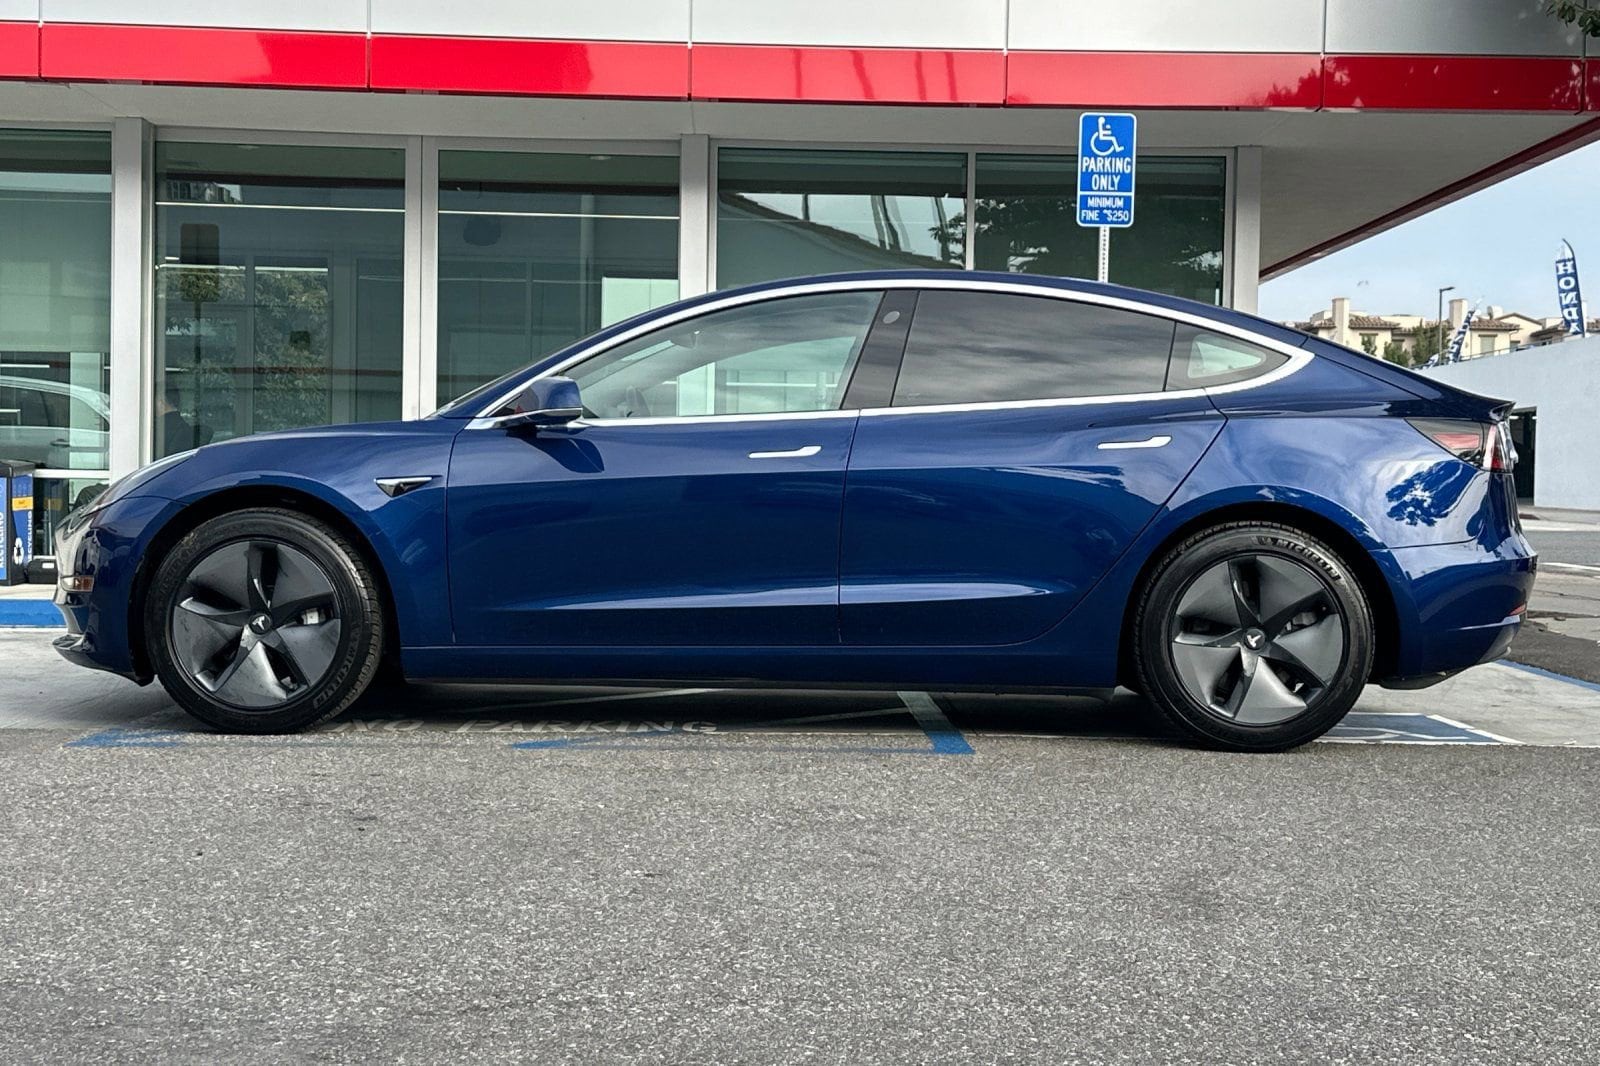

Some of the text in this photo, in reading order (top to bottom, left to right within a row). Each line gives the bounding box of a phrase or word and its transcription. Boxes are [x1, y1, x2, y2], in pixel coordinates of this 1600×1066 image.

[1082, 157, 1131, 174] PARKING
[1091, 174, 1120, 191] ONLY
[1087, 197, 1124, 208] MINIMUM
[1081, 209, 1100, 221] FINE
[1275, 539, 1340, 580] MICHELIN
[456, 719, 717, 733] PARKING
